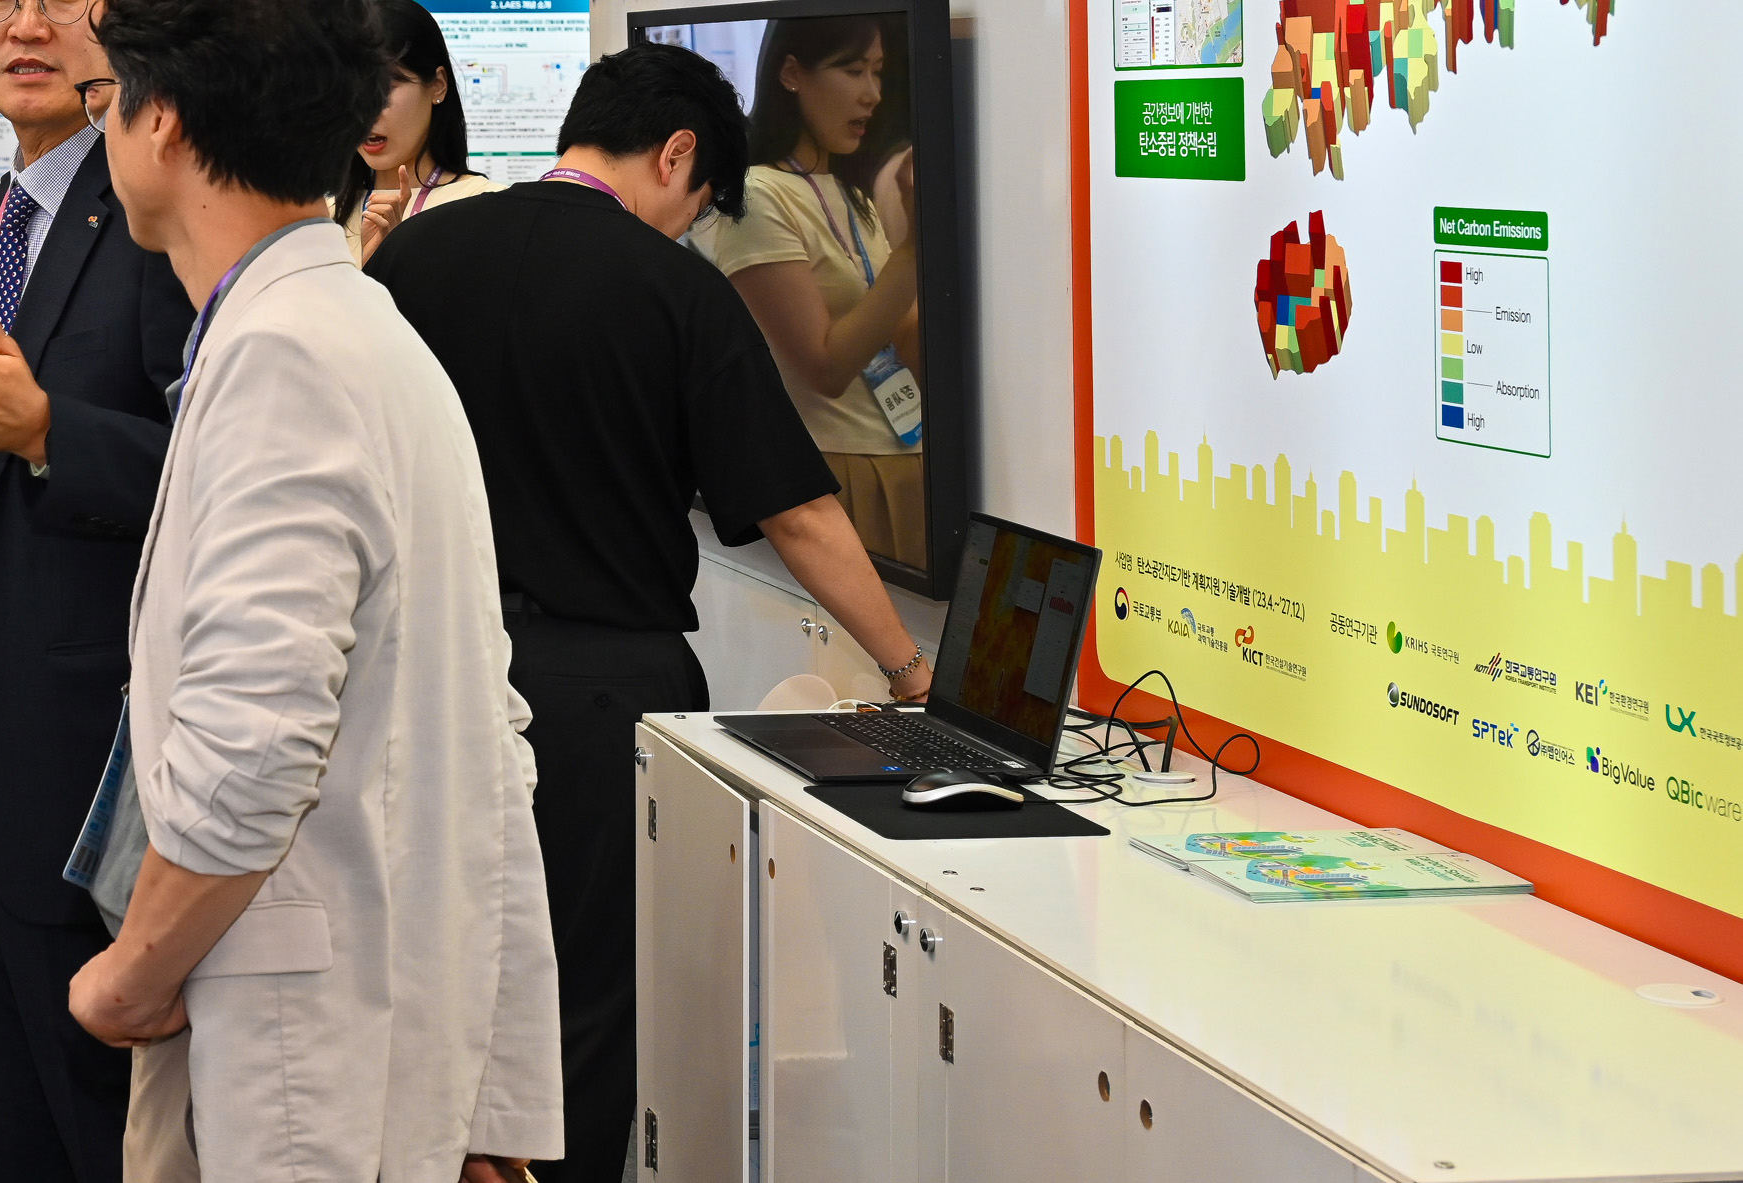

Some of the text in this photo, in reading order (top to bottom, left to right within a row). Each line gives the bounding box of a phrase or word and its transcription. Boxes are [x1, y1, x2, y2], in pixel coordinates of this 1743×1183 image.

[1142, 101, 1213, 126] 공간정보에 기반한
[1139, 131, 1217, 158] 탄소중립 정책수립
[1439, 217, 1542, 240] Net Carbon Emissions
[1465, 266, 1484, 283] High
[1495, 306, 1532, 324] Emission
[1466, 339, 1483, 355] Low
[1495, 380, 1540, 401] Absorption
[1467, 412, 1485, 430] High
[1115, 551, 1133, 572] 사업명
[1137, 556, 1191, 588] 탄소공간지도기반
[1192, 571, 1220, 597] 계획지원
[1222, 580, 1251, 606] 기술개발
[1132, 600, 1162, 623] 국토교통부
[1167, 618, 1190, 639] KAIA
[1330, 612, 1377, 645] 공동연구기관
[1242, 646, 1264, 667] KICT
[1405, 636, 1460, 665] KRIHS 국토연구원
[1505, 659, 1557, 686] 한국교통연구원
[1575, 681, 1599, 707] KEI
[1400, 691, 1459, 725] SUNDOSOFT
[1472, 719, 1514, 749] SPTek
[1665, 704, 1697, 738] LX
[1700, 727, 1743, 751] 한국국토정보공
[1602, 757, 1655, 791] BigValue
